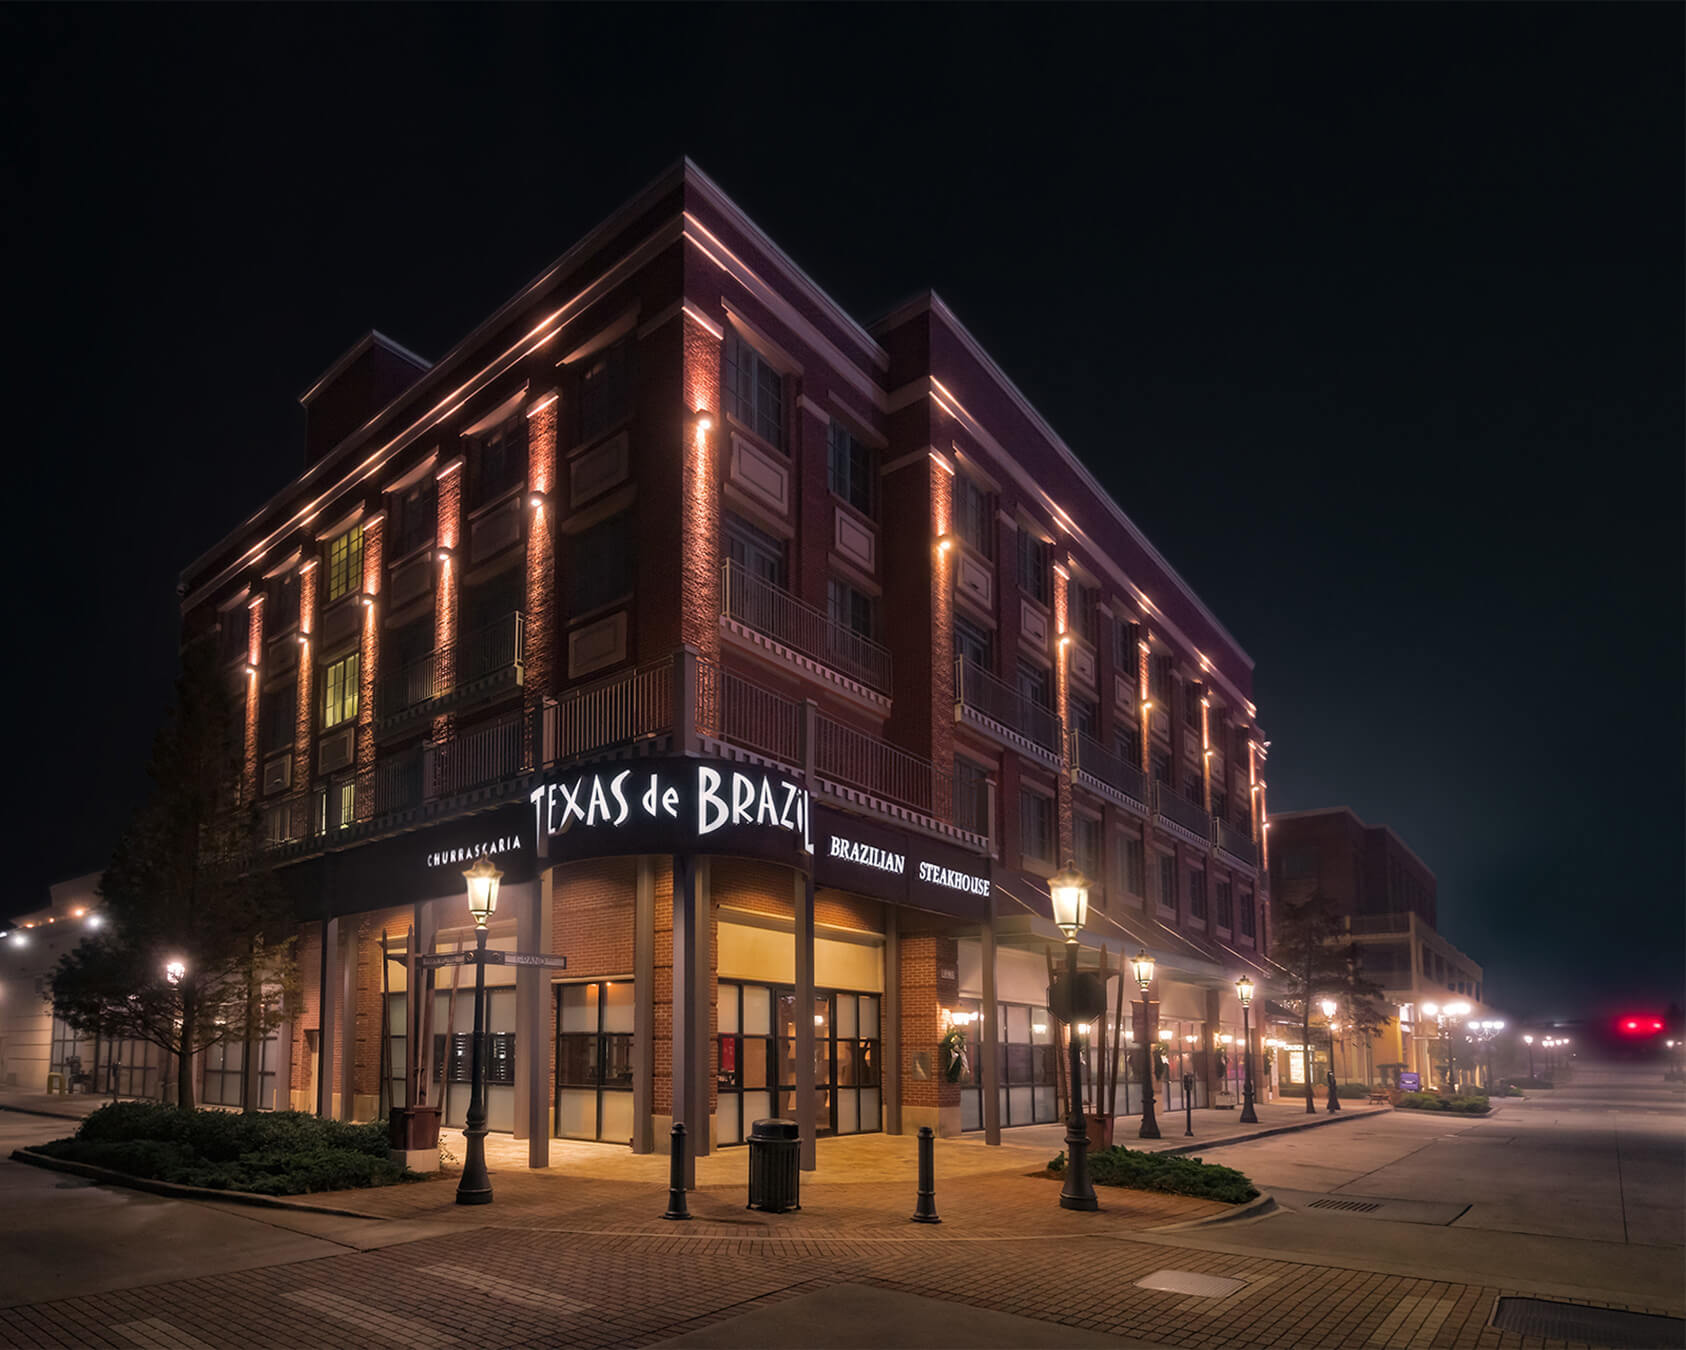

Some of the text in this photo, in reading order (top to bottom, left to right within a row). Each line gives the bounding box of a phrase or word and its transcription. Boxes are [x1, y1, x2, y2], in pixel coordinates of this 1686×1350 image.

[530, 769, 632, 850] TEXAS
[642, 773, 680, 817] de
[427, 835, 521, 867] CHURRASCARIA
[830, 835, 990, 897] BRAZILIAN STEAKHOUSE
